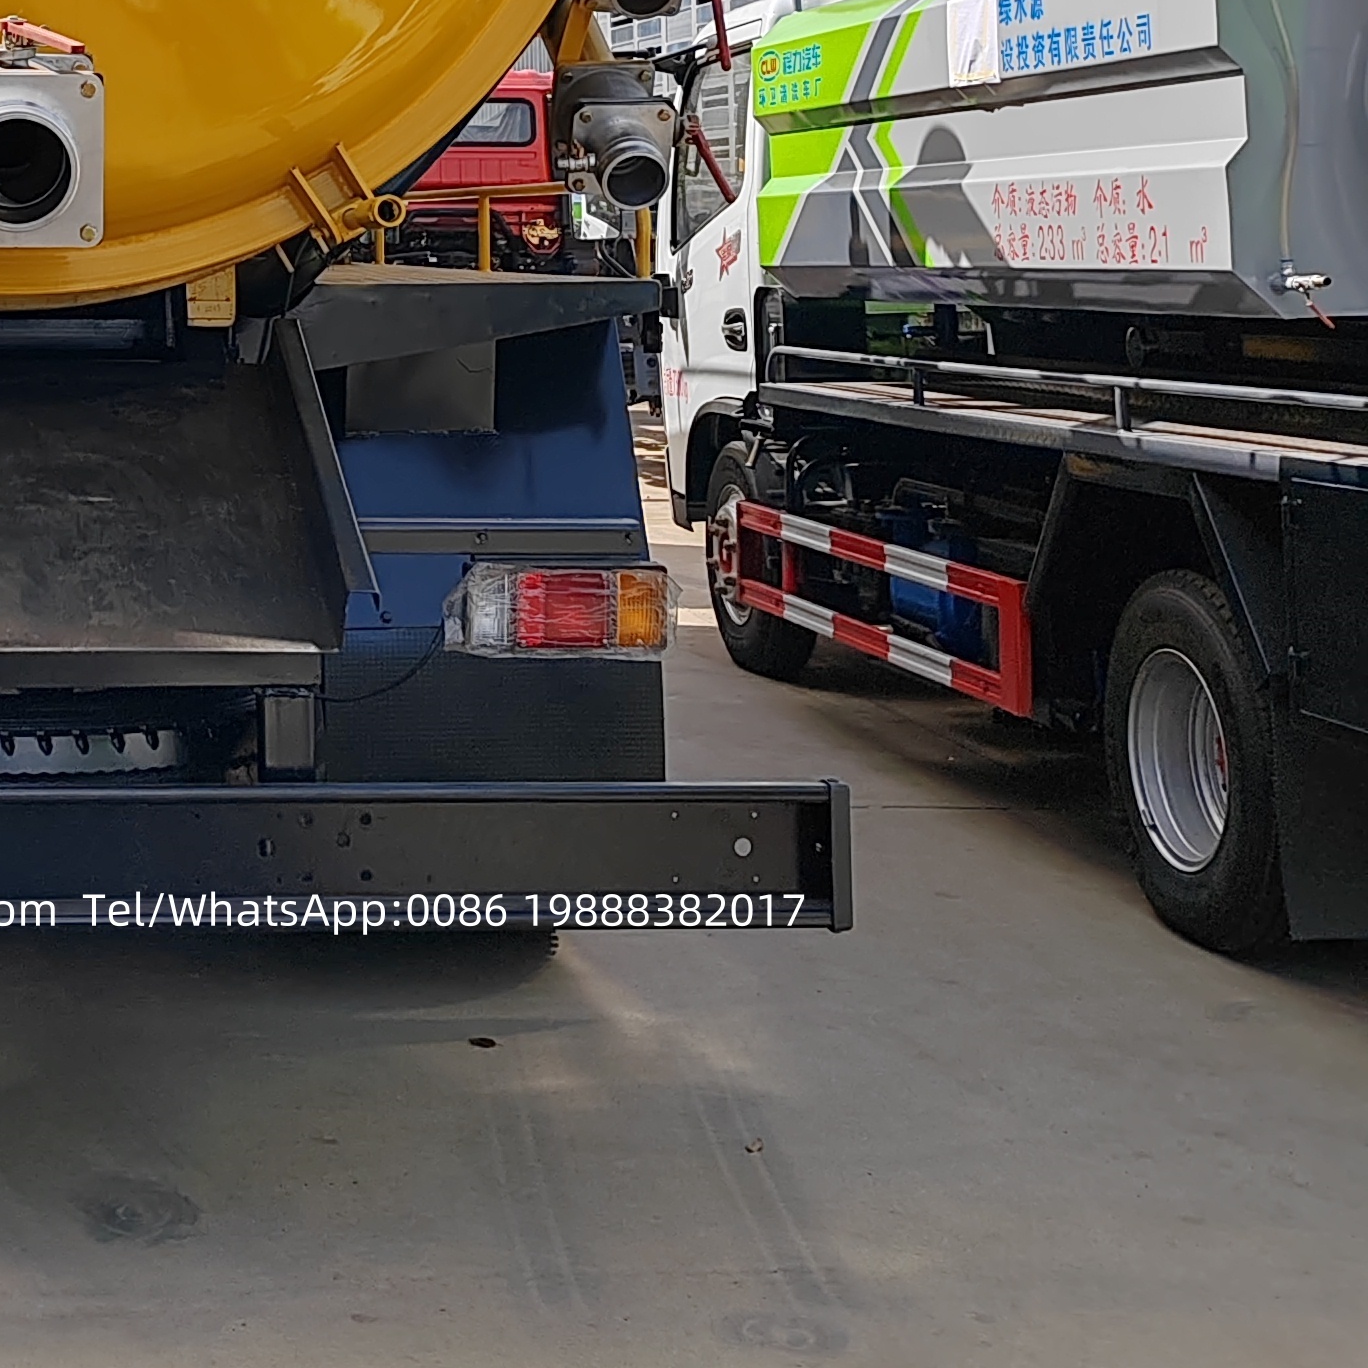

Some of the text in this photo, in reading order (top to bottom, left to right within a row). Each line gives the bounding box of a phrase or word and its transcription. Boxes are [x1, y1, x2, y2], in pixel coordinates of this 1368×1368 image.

[1001, 13, 1152, 72] 设投资有限责任公司
